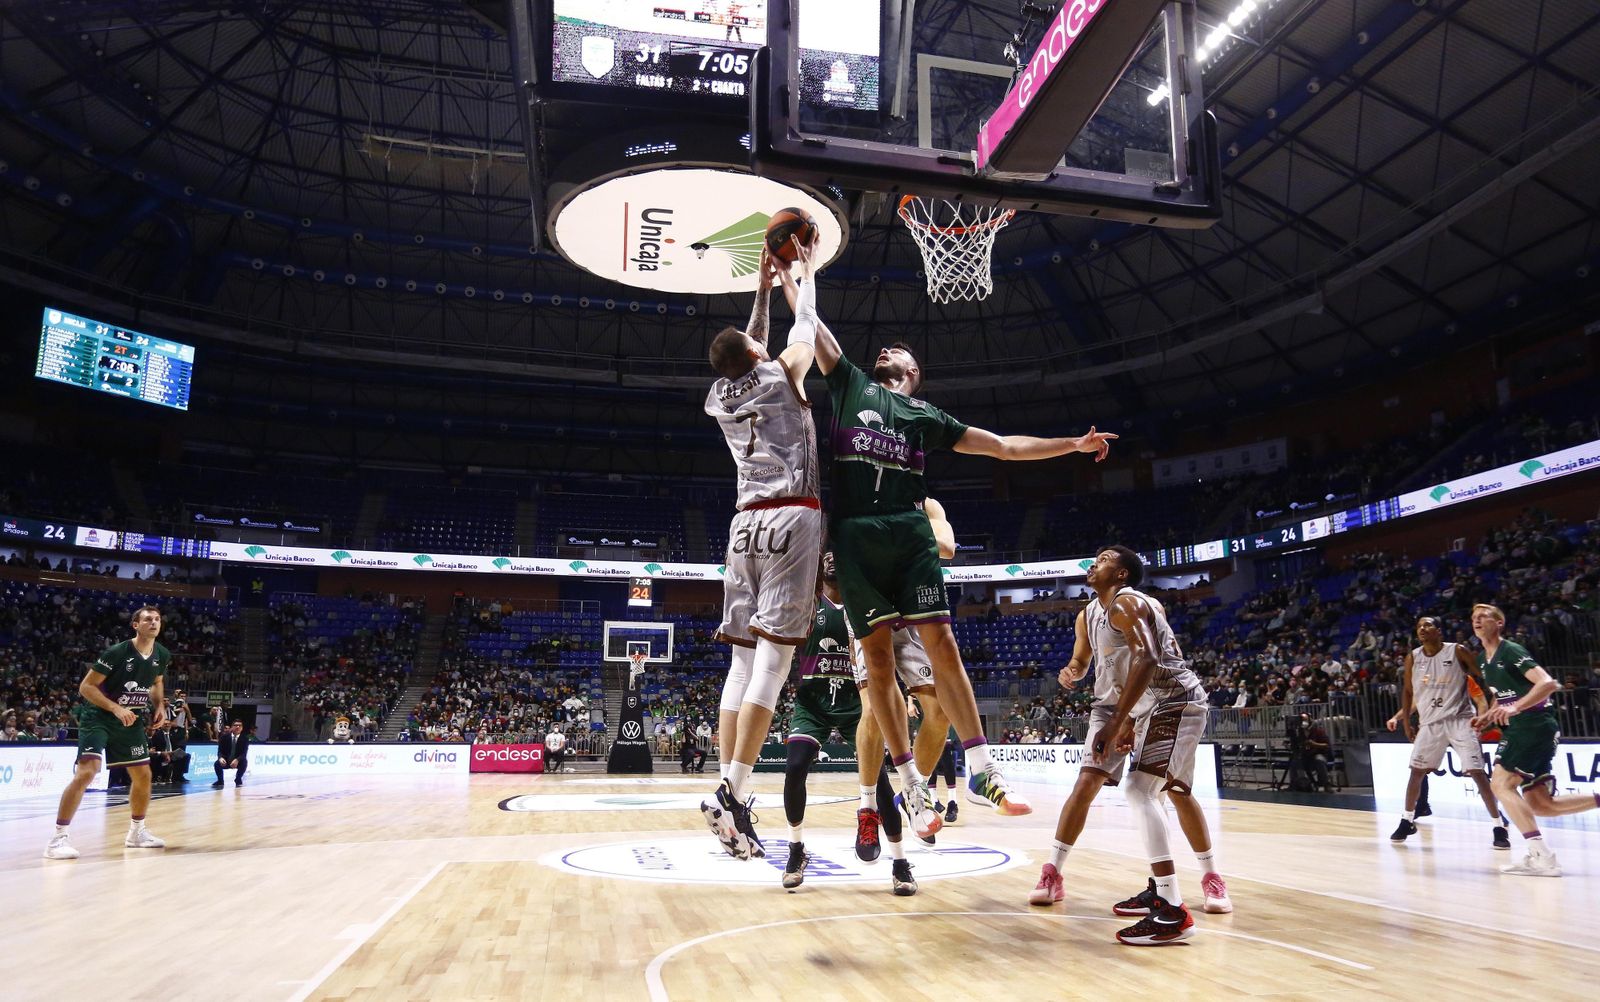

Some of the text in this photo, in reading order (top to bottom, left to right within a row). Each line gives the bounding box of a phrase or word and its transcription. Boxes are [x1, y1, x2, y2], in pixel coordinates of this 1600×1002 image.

[635, 43, 661, 64] 31
[698, 51, 749, 75] 7:05
[711, 80, 745, 95] CUARTO
[630, 207, 674, 272] Unicaja
[95, 324, 109, 336] 31
[135, 335, 150, 346] 24
[114, 344, 128, 355] 2T
[109, 358, 135, 373] 7:05
[736, 411, 758, 458] 7
[750, 466, 785, 477] Recoletas
[1543, 460, 1578, 475] Unicaja
[1450, 481, 1503, 500] Unicaja Banco
[43, 524, 66, 540] 24
[732, 520, 792, 555] atu
[1281, 527, 1296, 543] 24
[1231, 538, 1246, 552] 31
[265, 553, 315, 563] Unicaja Banco
[350, 558, 376, 566] Unicaja
[432, 561, 457, 570] Unicaja
[510, 564, 535, 573] Unicaja
[587, 567, 611, 576] Unicaja
[661, 570, 685, 578] Unicaja
[950, 572, 974, 581] Unicaja
[1023, 568, 1065, 577] Unicaja Banco
[632, 587, 649, 599] 24
[917, 594, 941, 605] laga
[1430, 697, 1443, 708] 32
[264, 755, 295, 765] MUY
[299, 755, 338, 765] POCO
[413, 749, 457, 763] divina
[475, 747, 542, 761] endesa
[1006, 748, 1019, 761] LAS
[1021, 749, 1056, 763] NORMAS
